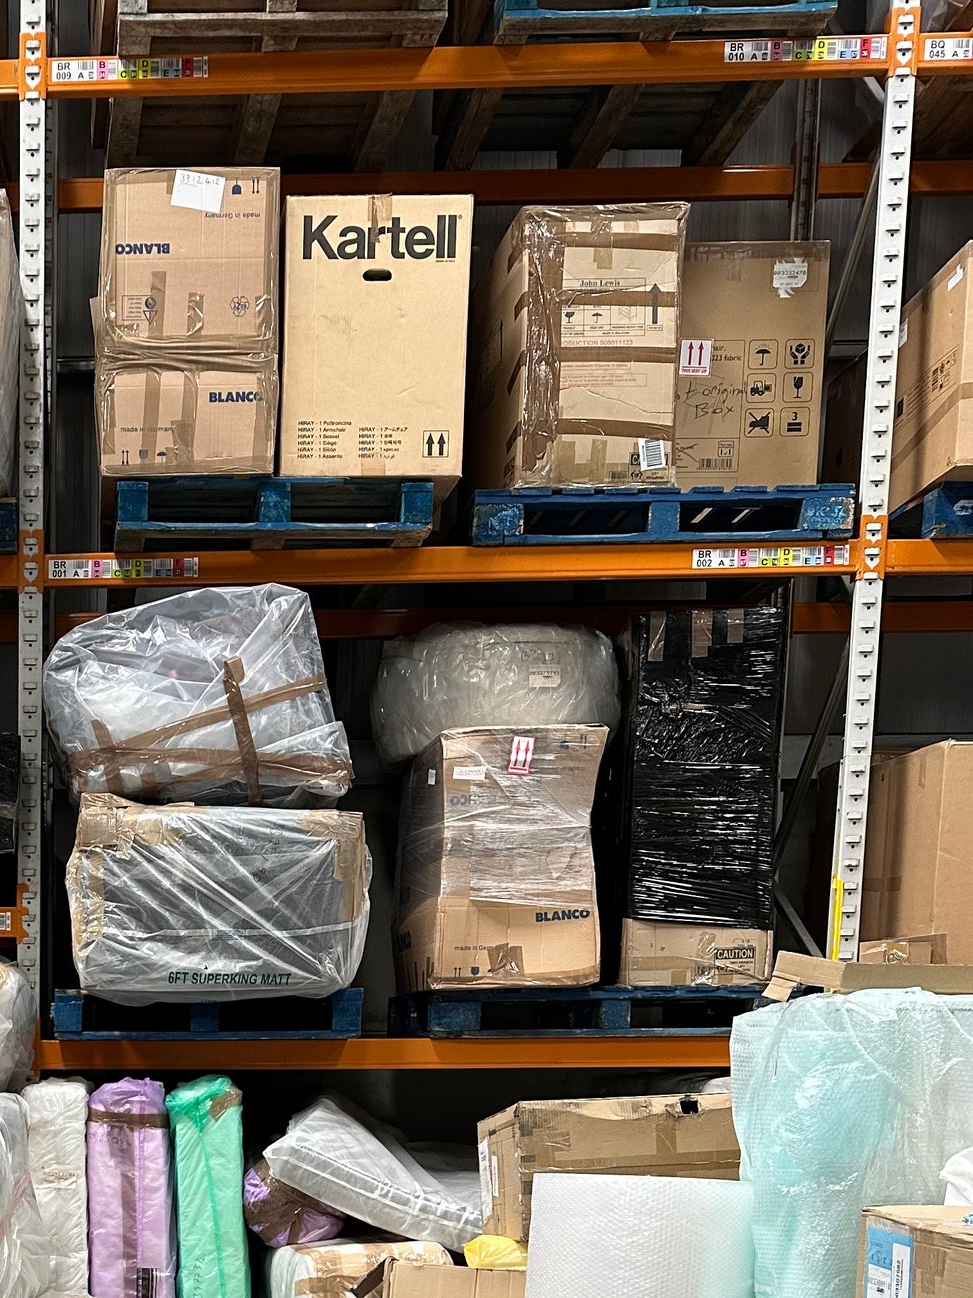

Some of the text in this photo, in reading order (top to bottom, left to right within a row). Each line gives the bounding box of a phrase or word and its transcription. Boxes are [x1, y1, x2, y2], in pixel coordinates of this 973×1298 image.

[730, 43, 744, 51] BR
[818, 41, 826, 49] D
[931, 40, 946, 50] BQ
[728, 52, 744, 61] 010
[929, 50, 946, 58] 045
[57, 62, 70, 71] BR
[302, 214, 457, 260] Kartell
[115, 243, 170, 254] BLANCO
[695, 402, 734, 419] Box
[792, 412, 798, 420] 3
[54, 561, 66, 569] BR
[696, 559, 712, 567] 002
[536, 909, 590, 922] BLANCO
[717, 949, 753, 958] CAUTION
[168, 971, 291, 986] 6FT SUPERKING MATT
